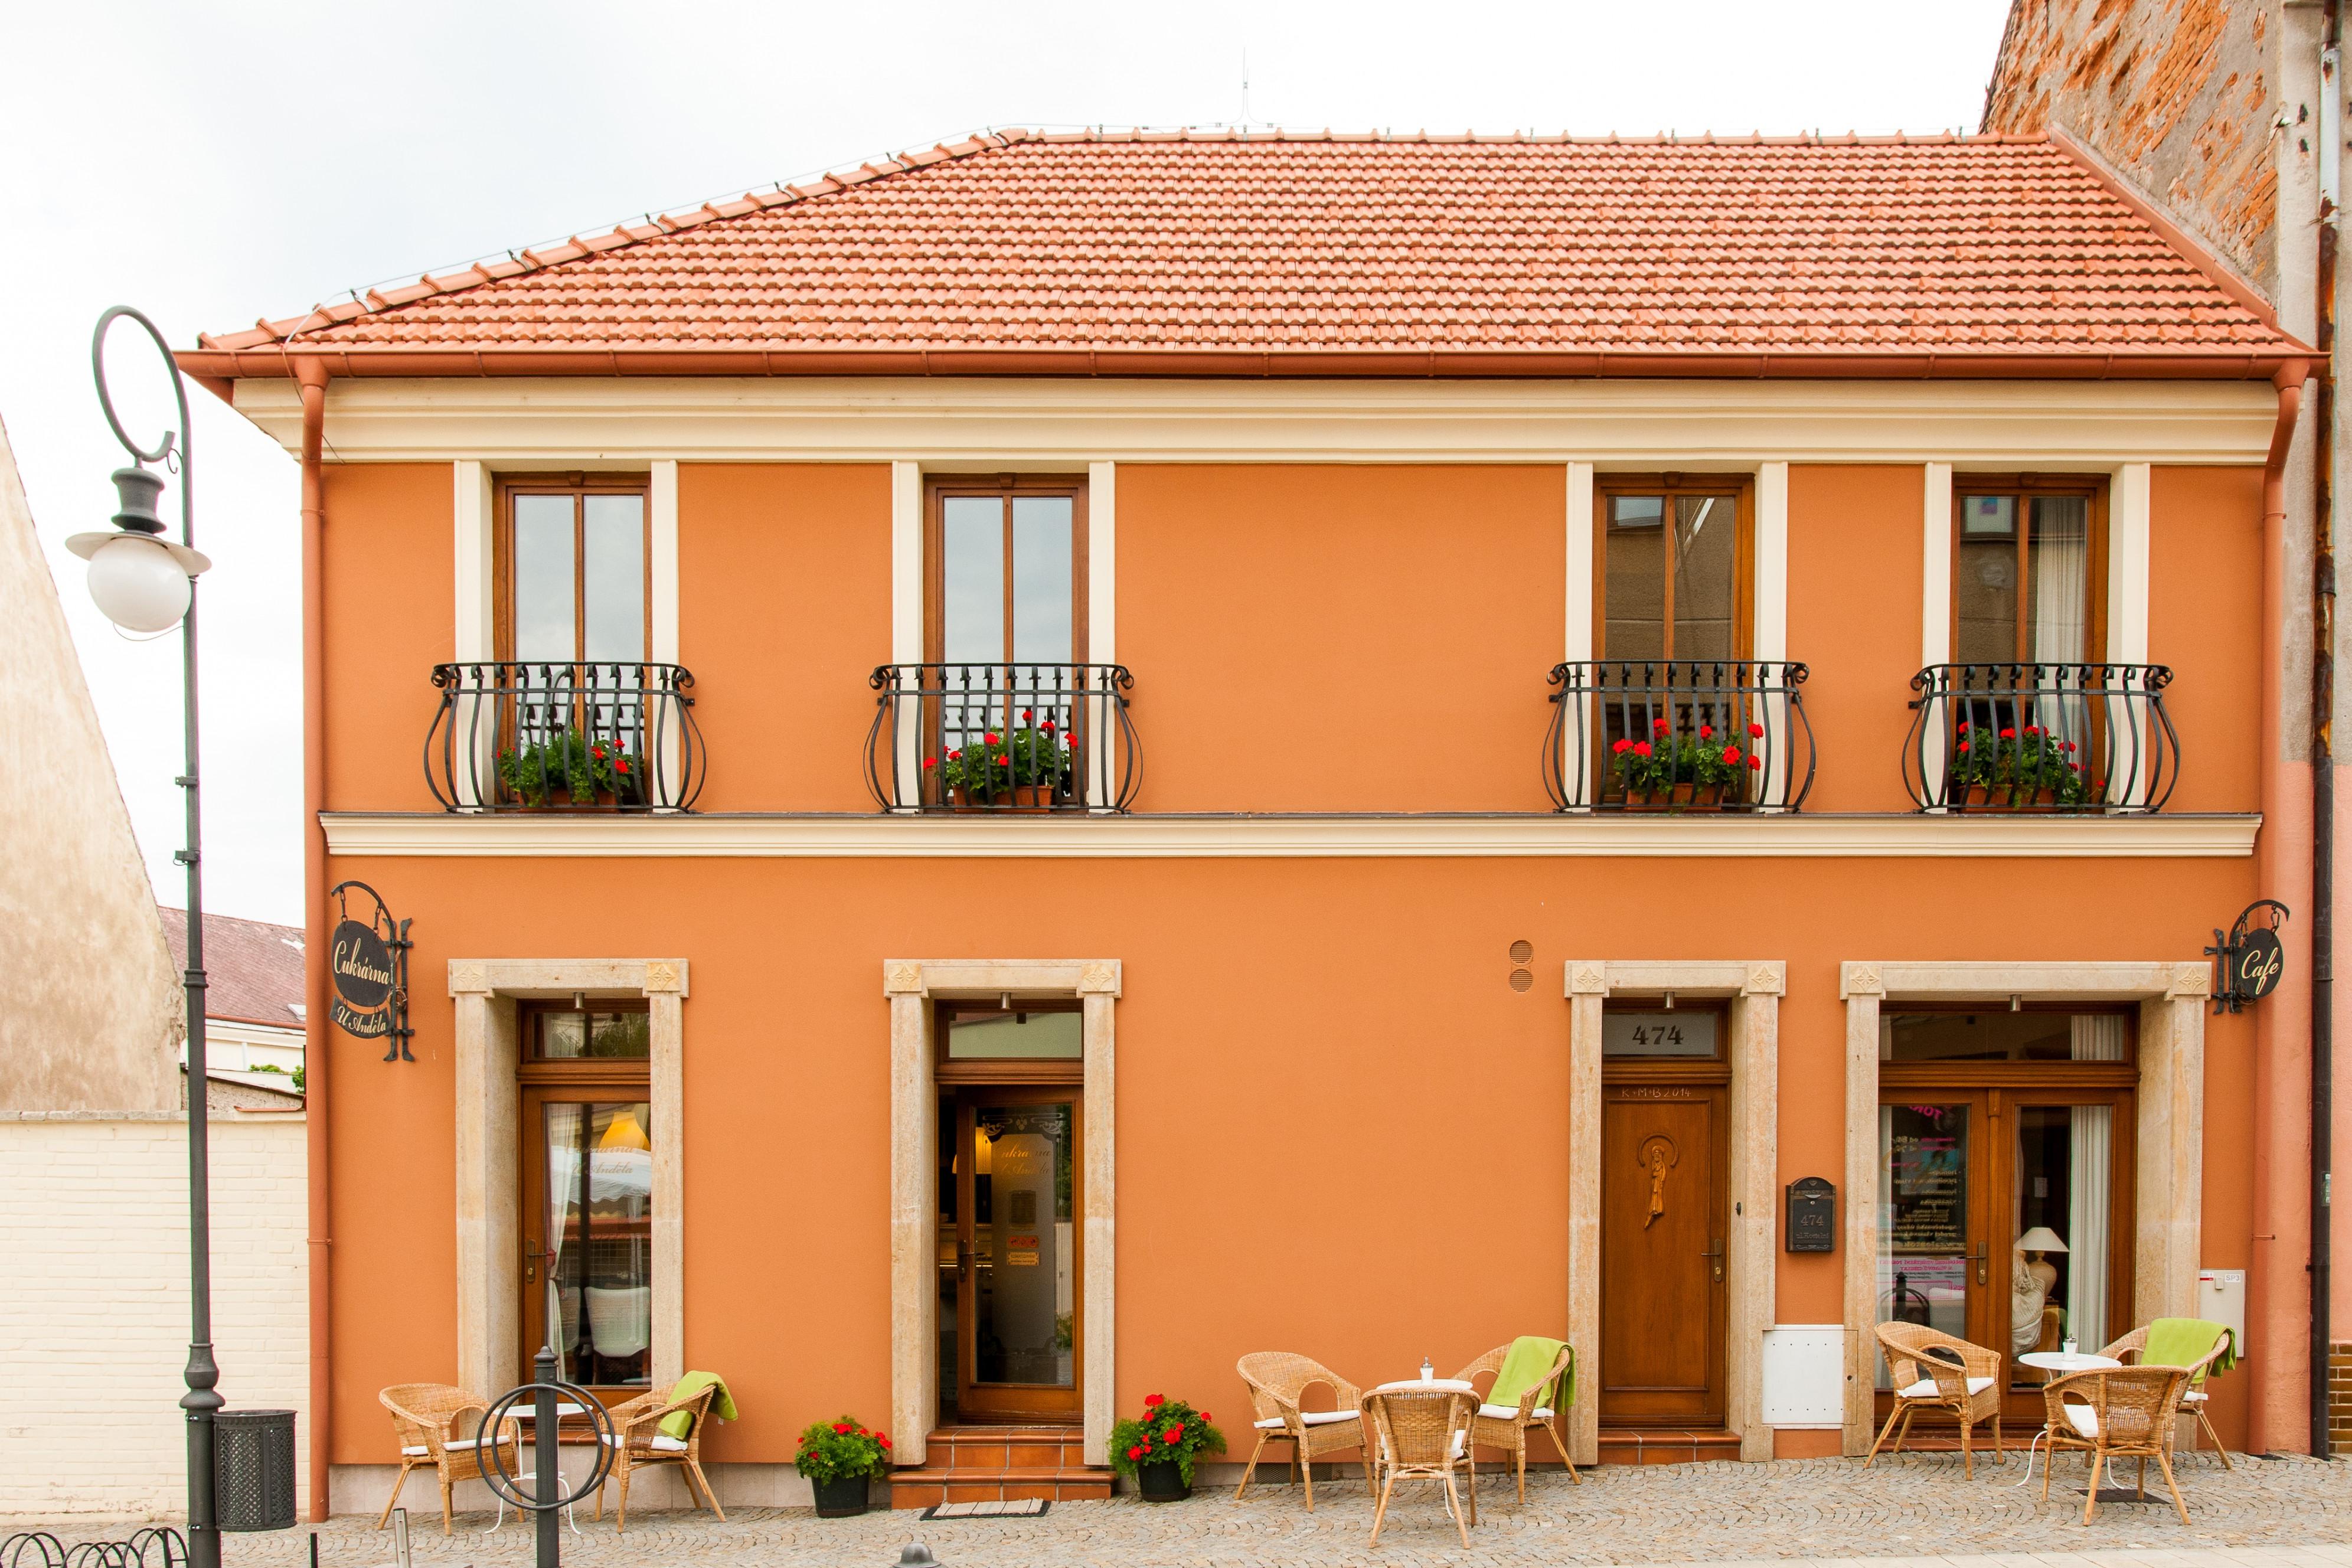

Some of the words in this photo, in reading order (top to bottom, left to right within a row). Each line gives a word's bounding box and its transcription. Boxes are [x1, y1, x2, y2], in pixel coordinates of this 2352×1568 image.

[334, 937, 390, 985] Cukrárna
[2241, 947, 2280, 995] Cafe
[337, 1005, 347, 1026] U
[348, 1014, 387, 1034] Anděla
[1632, 1024, 1684, 1045] 474
[1801, 1215, 1824, 1226] 474
